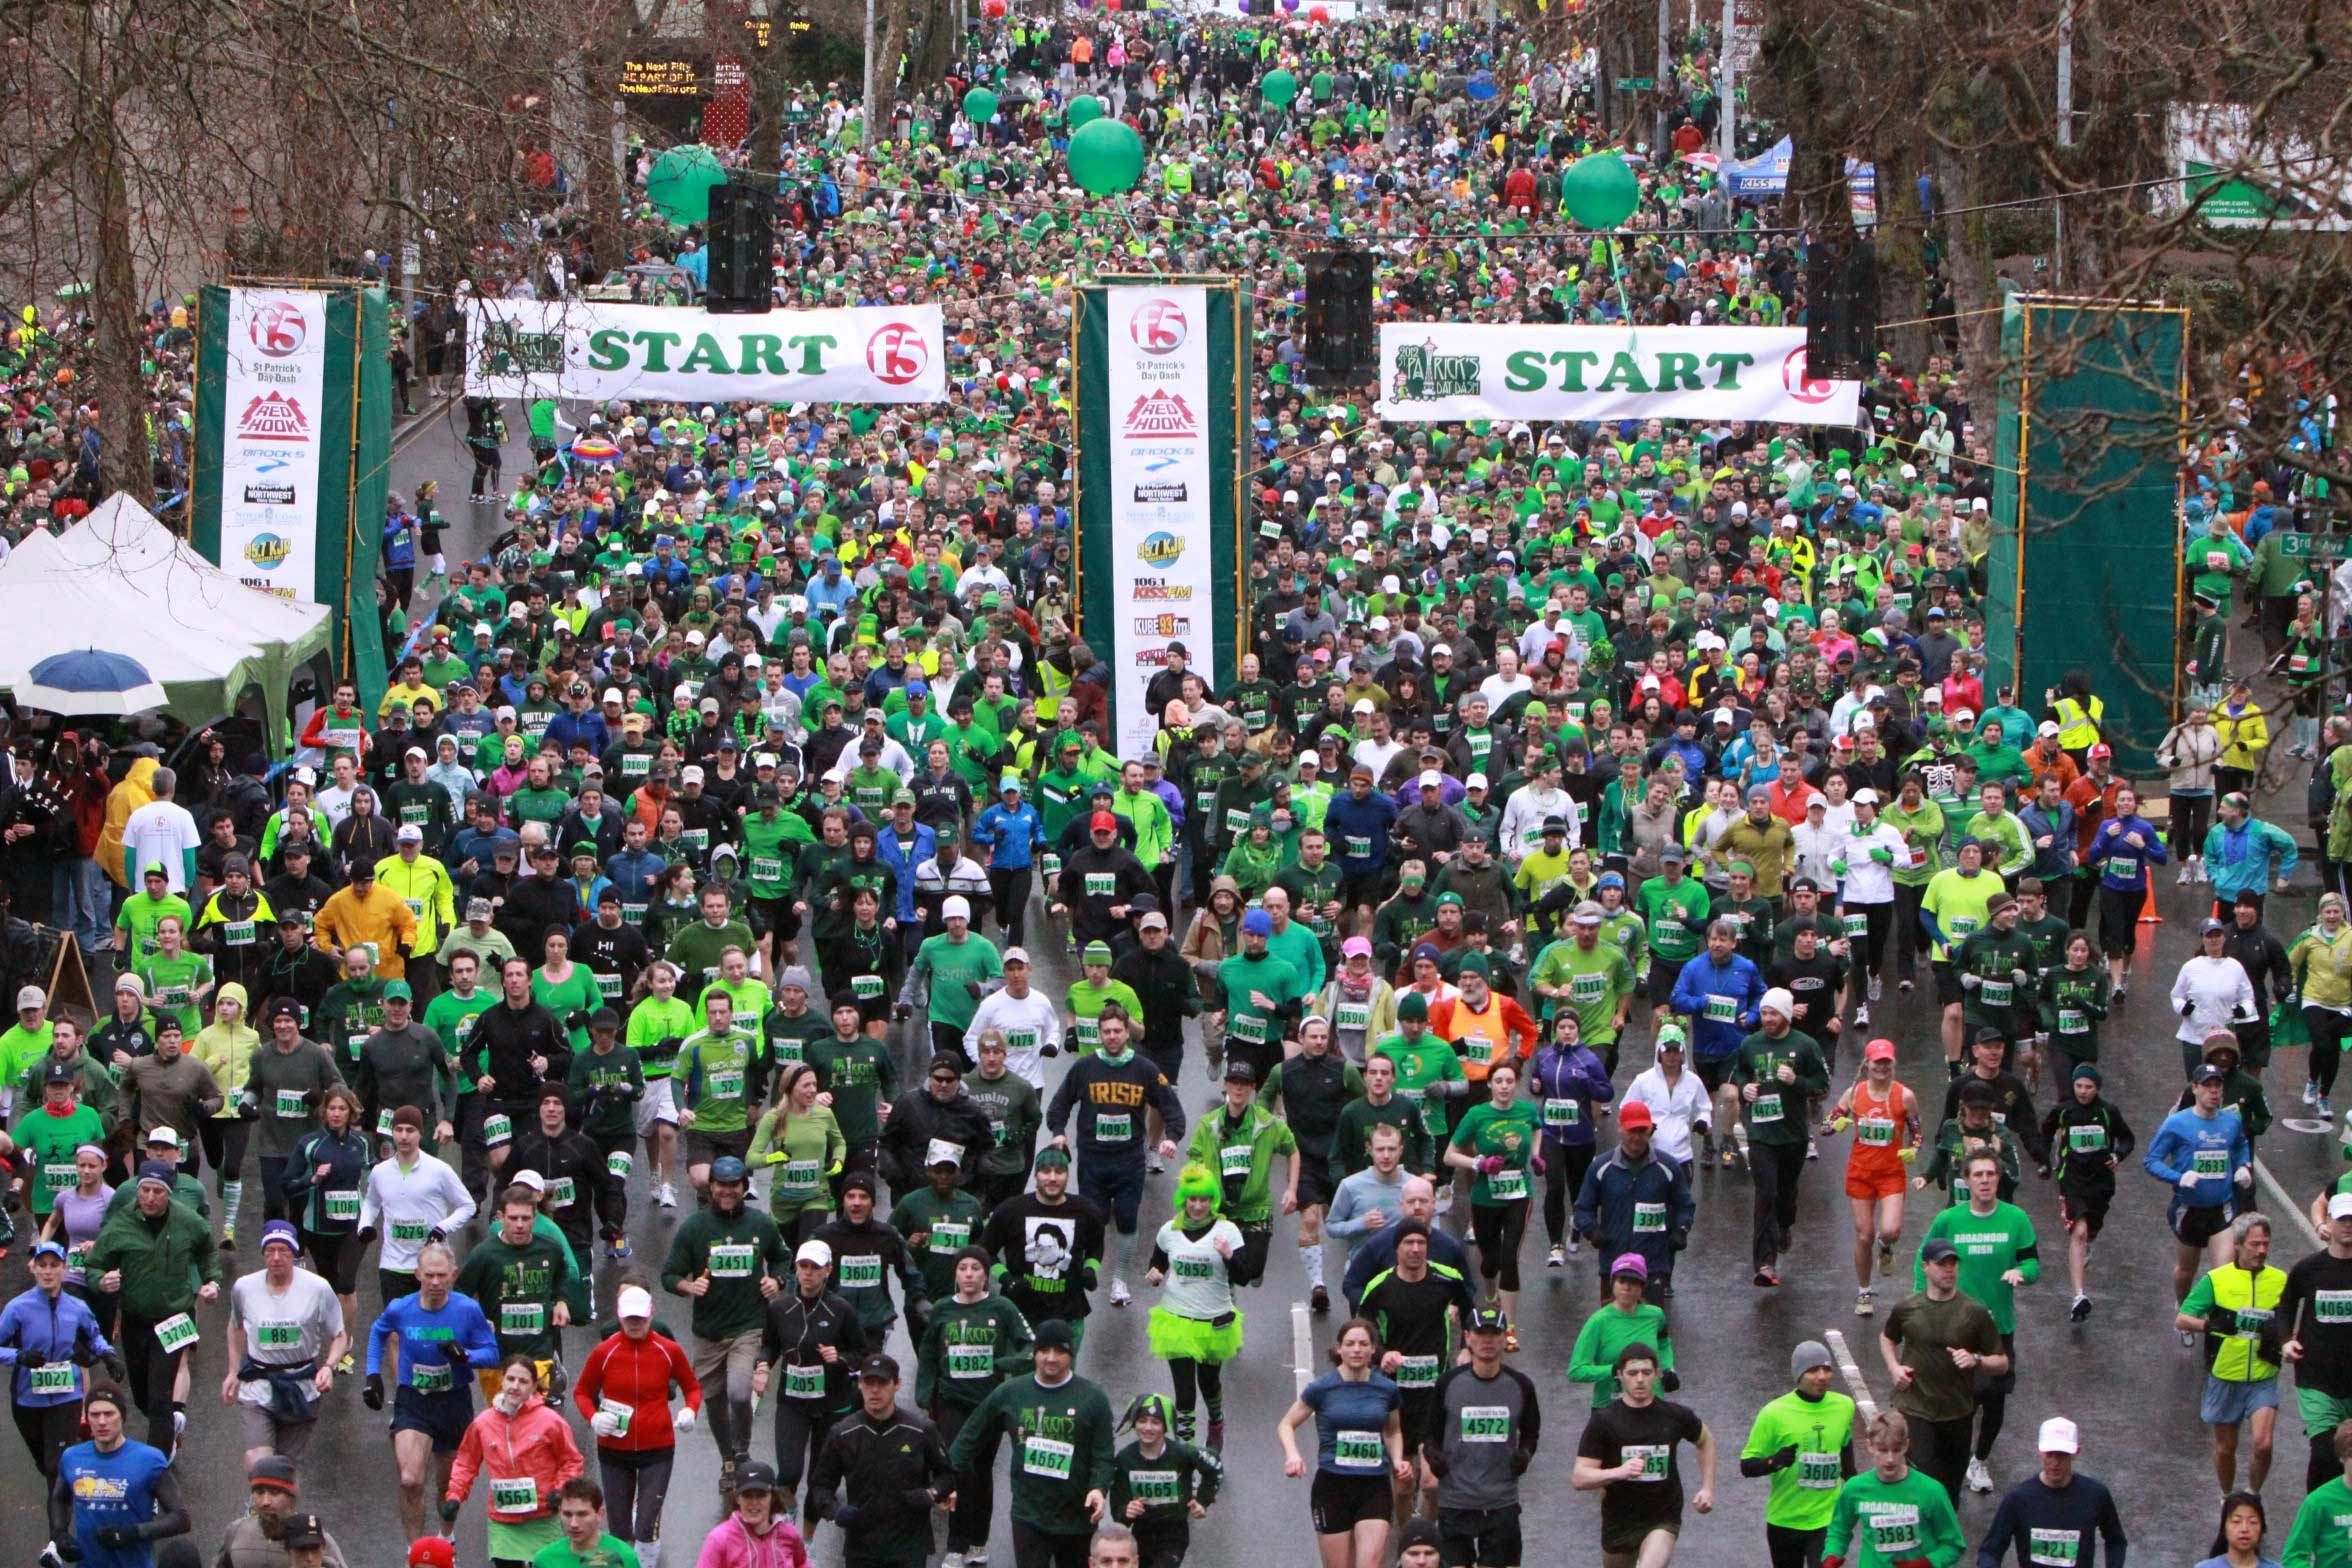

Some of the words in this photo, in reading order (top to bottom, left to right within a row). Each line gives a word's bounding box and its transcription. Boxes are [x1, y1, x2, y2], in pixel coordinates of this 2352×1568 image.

[625, 62, 643, 71] The
[646, 62, 667, 71] Next
[1742, 180, 1769, 188] KISS
[588, 329, 838, 376] START
[263, 363, 301, 374] Patrick's
[1136, 361, 1147, 370] St
[1149, 361, 1185, 370] Patrick's
[1504, 349, 1755, 393] START
[258, 373, 272, 384] Day
[275, 373, 296, 384] Dash
[1141, 372, 1157, 381] Day
[1159, 371, 1180, 380] Dash
[255, 406, 291, 418] RED
[1142, 404, 1178, 415] RED
[247, 419, 299, 433] HOOK
[1133, 417, 1187, 430] HOOK
[248, 491, 293, 500] NORTHWEST
[1137, 490, 1184, 498] NORTHWEST
[2286, 536, 2311, 553] 3rd
[2322, 541, 2344, 552] Ave
[1134, 578, 1166, 587] 106.1
[1135, 618, 1159, 634] KUBE
[1159, 615, 1174, 635] 93
[1136, 649, 1166, 660] SPORTS
[521, 711, 556, 727] PORTLAN
[598, 940, 614, 952] HI
[1008, 1034, 1036, 1045] 4179
[55, 1066, 62, 1075] S
[721, 1080, 735, 1093] 52
[1087, 1081, 1145, 1107] IRISH
[2080, 1135, 2094, 1147] 80
[787, 1170, 816, 1183] 4093
[394, 1226, 425, 1239] 3279
[944, 1233, 958, 1247] 51
[1968, 1245, 1993, 1255] IRISH
[716, 1255, 748, 1270] 3451
[1176, 1261, 1208, 1277] 2852
[511, 1314, 534, 1328] 101
[165, 1324, 194, 1342] 3781
[271, 1328, 288, 1343] 88
[954, 1357, 989, 1371] 4382
[36, 1371, 68, 1386] 3027
[791, 1376, 816, 1391] 205
[1467, 1419, 1505, 1434] 4572
[1029, 1448, 1065, 1469] 4667
[1646, 1456, 1665, 1473] 65
[497, 1490, 532, 1505] 4563
